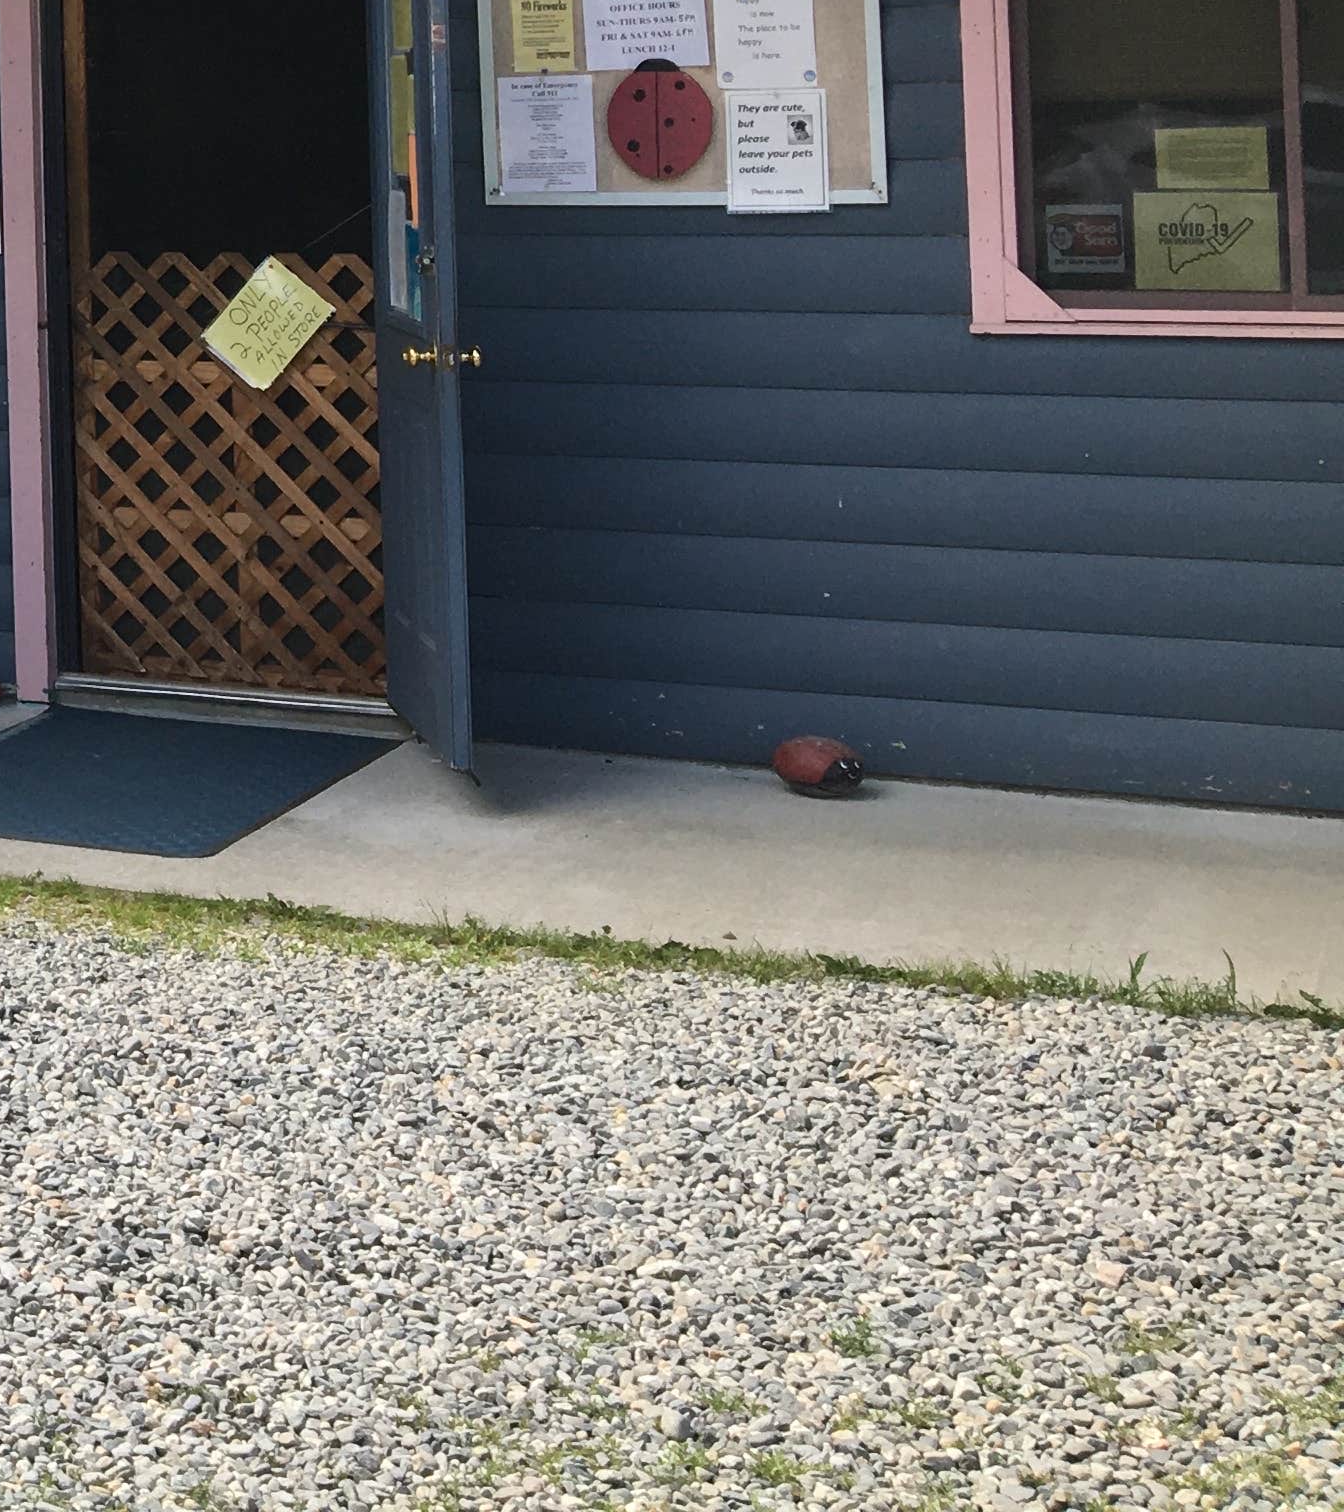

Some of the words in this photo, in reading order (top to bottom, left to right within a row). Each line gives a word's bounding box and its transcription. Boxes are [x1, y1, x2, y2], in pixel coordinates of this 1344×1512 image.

[648, 1, 680, 10] HOURS
[738, 24, 753, 32] The
[738, 104, 760, 114] They
[763, 104, 779, 112] are
[738, 120, 754, 128] but
[737, 134, 770, 145] please
[739, 150, 765, 158] leave
[767, 151, 790, 159] your
[792, 150, 813, 159] pets
[228, 270, 272, 326] ONLY
[230, 342, 252, 360] 2
[245, 283, 299, 343] PEOPLE
[256, 301, 304, 364] ALLOWED
[271, 348, 288, 370] IN
[288, 305, 322, 348] STORE
